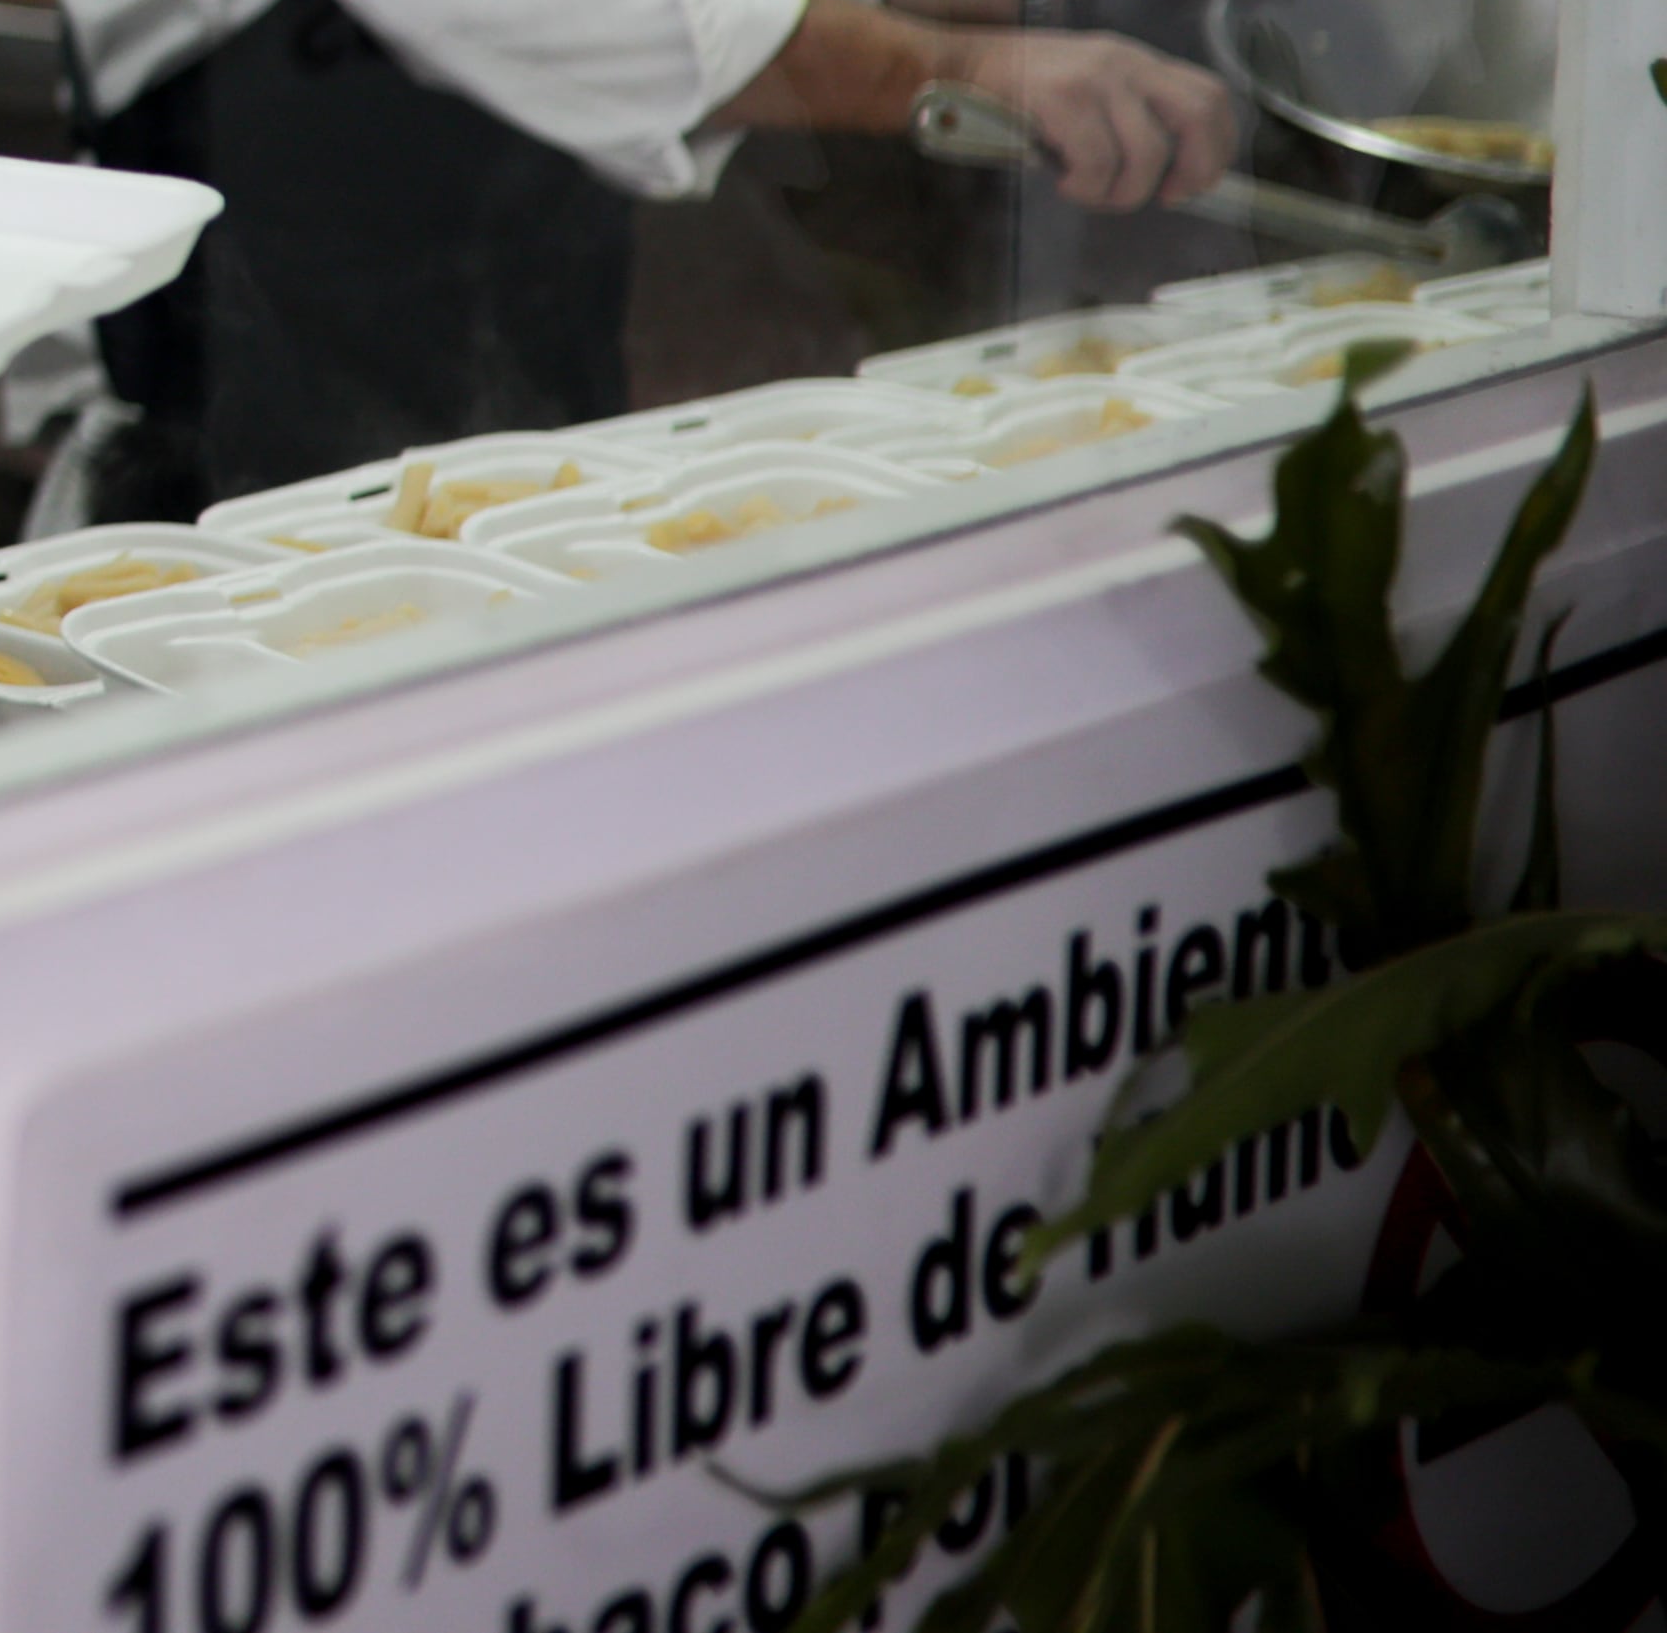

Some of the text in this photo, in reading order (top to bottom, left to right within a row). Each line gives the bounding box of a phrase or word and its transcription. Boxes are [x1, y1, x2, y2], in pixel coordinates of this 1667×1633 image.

[107, 1390, 496, 1633] 100%
[547, 1274, 867, 1515] Libre
[910, 1186, 1045, 1353] de
[111, 1220, 439, 1466] Este
[484, 1148, 637, 1311] es
[683, 1069, 829, 1235] un
